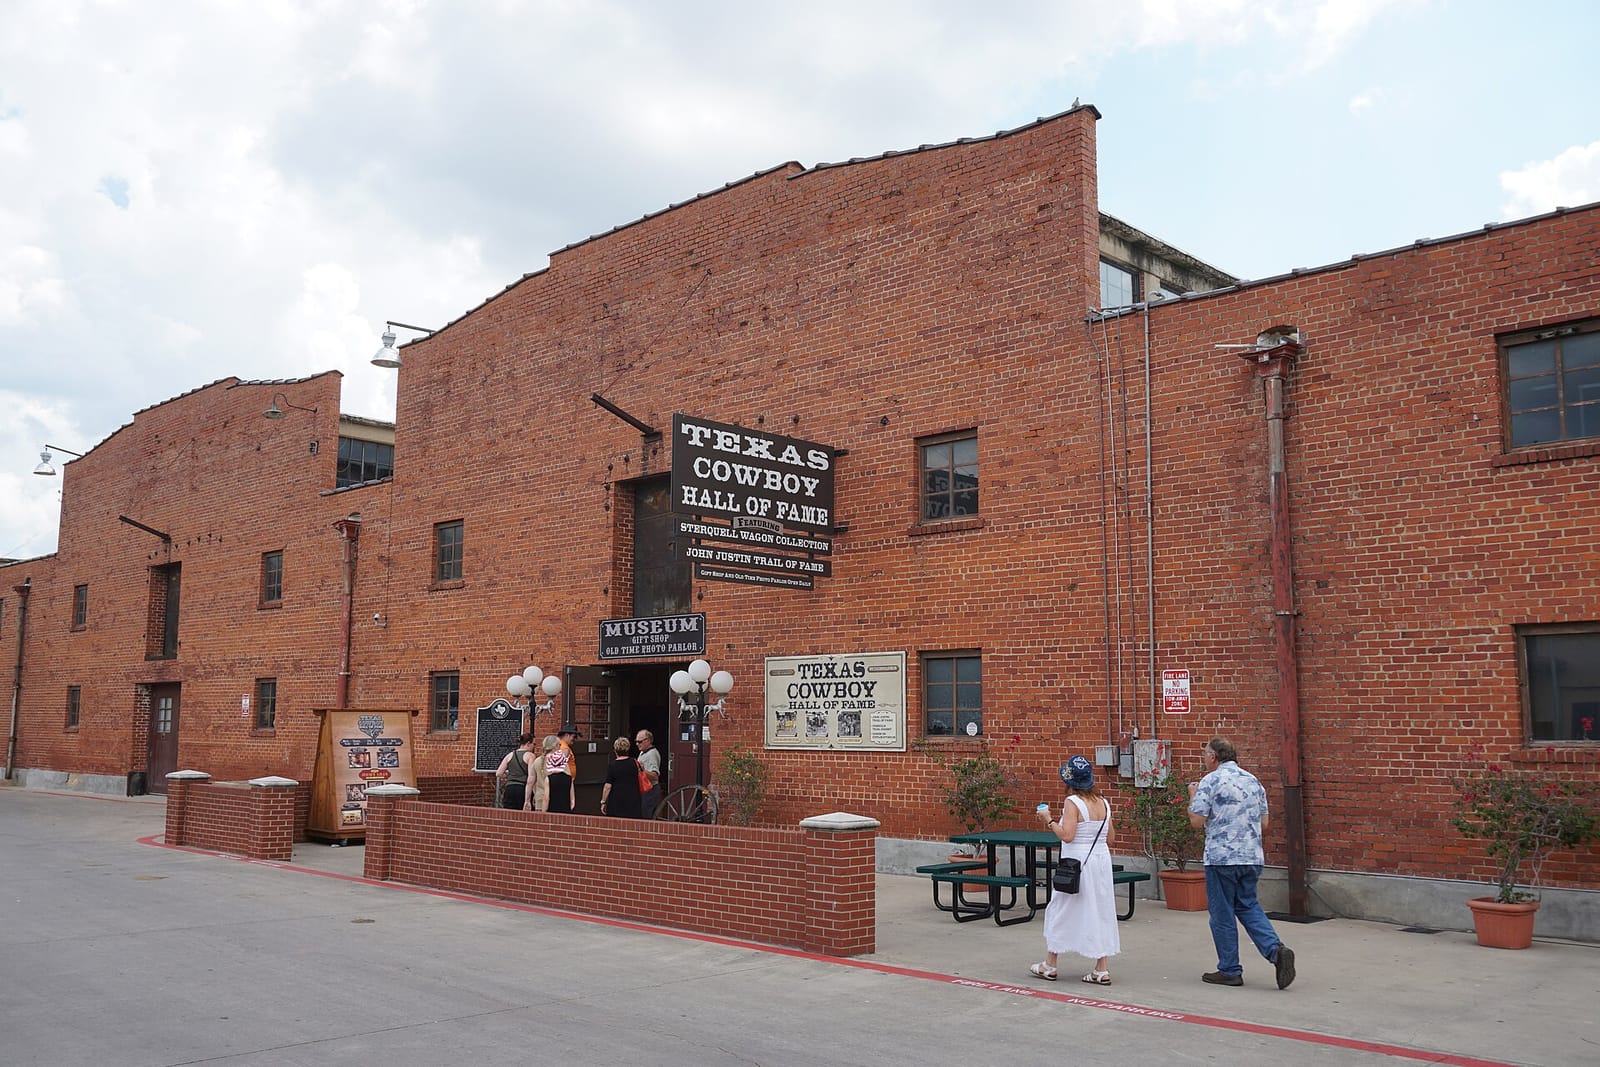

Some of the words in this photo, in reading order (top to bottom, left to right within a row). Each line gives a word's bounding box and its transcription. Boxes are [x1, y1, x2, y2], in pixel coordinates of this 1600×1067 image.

[681, 423, 830, 471] TEXAS
[693, 456, 820, 498] COWBOY
[681, 485, 741, 513] HALL
[745, 496, 772, 517] OF
[775, 500, 829, 526] FAME
[737, 517, 780, 532] FEATURING
[680, 522, 739, 539] STERQUELL
[739, 530, 774, 544] WAGON
[775, 535, 829, 551] COLLECTION
[686, 547, 714, 559] JOHN
[715, 551, 752, 564] JUSTIN
[753, 555, 784, 568] TRAIL
[785, 559, 798, 569] OF
[798, 561, 824, 572] FAME
[604, 616, 699, 637] MUSEUM
[605, 646, 619, 655] OLD
[620, 645, 640, 655] TIME
[641, 644, 666, 654] PHOTO
[667, 642, 697, 652] PARLOR
[631, 635, 650, 645] GIFT
[650, 633, 670, 643] SHOP
[797, 661, 866, 680] TEXAS
[787, 680, 878, 699] COWBOY
[1165, 687, 1188, 695] PARKING
[788, 700, 821, 710] HALL
[823, 700, 839, 709] OF
[841, 700, 876, 709] FAME
[1097, 1002, 1185, 1020] PARKING
